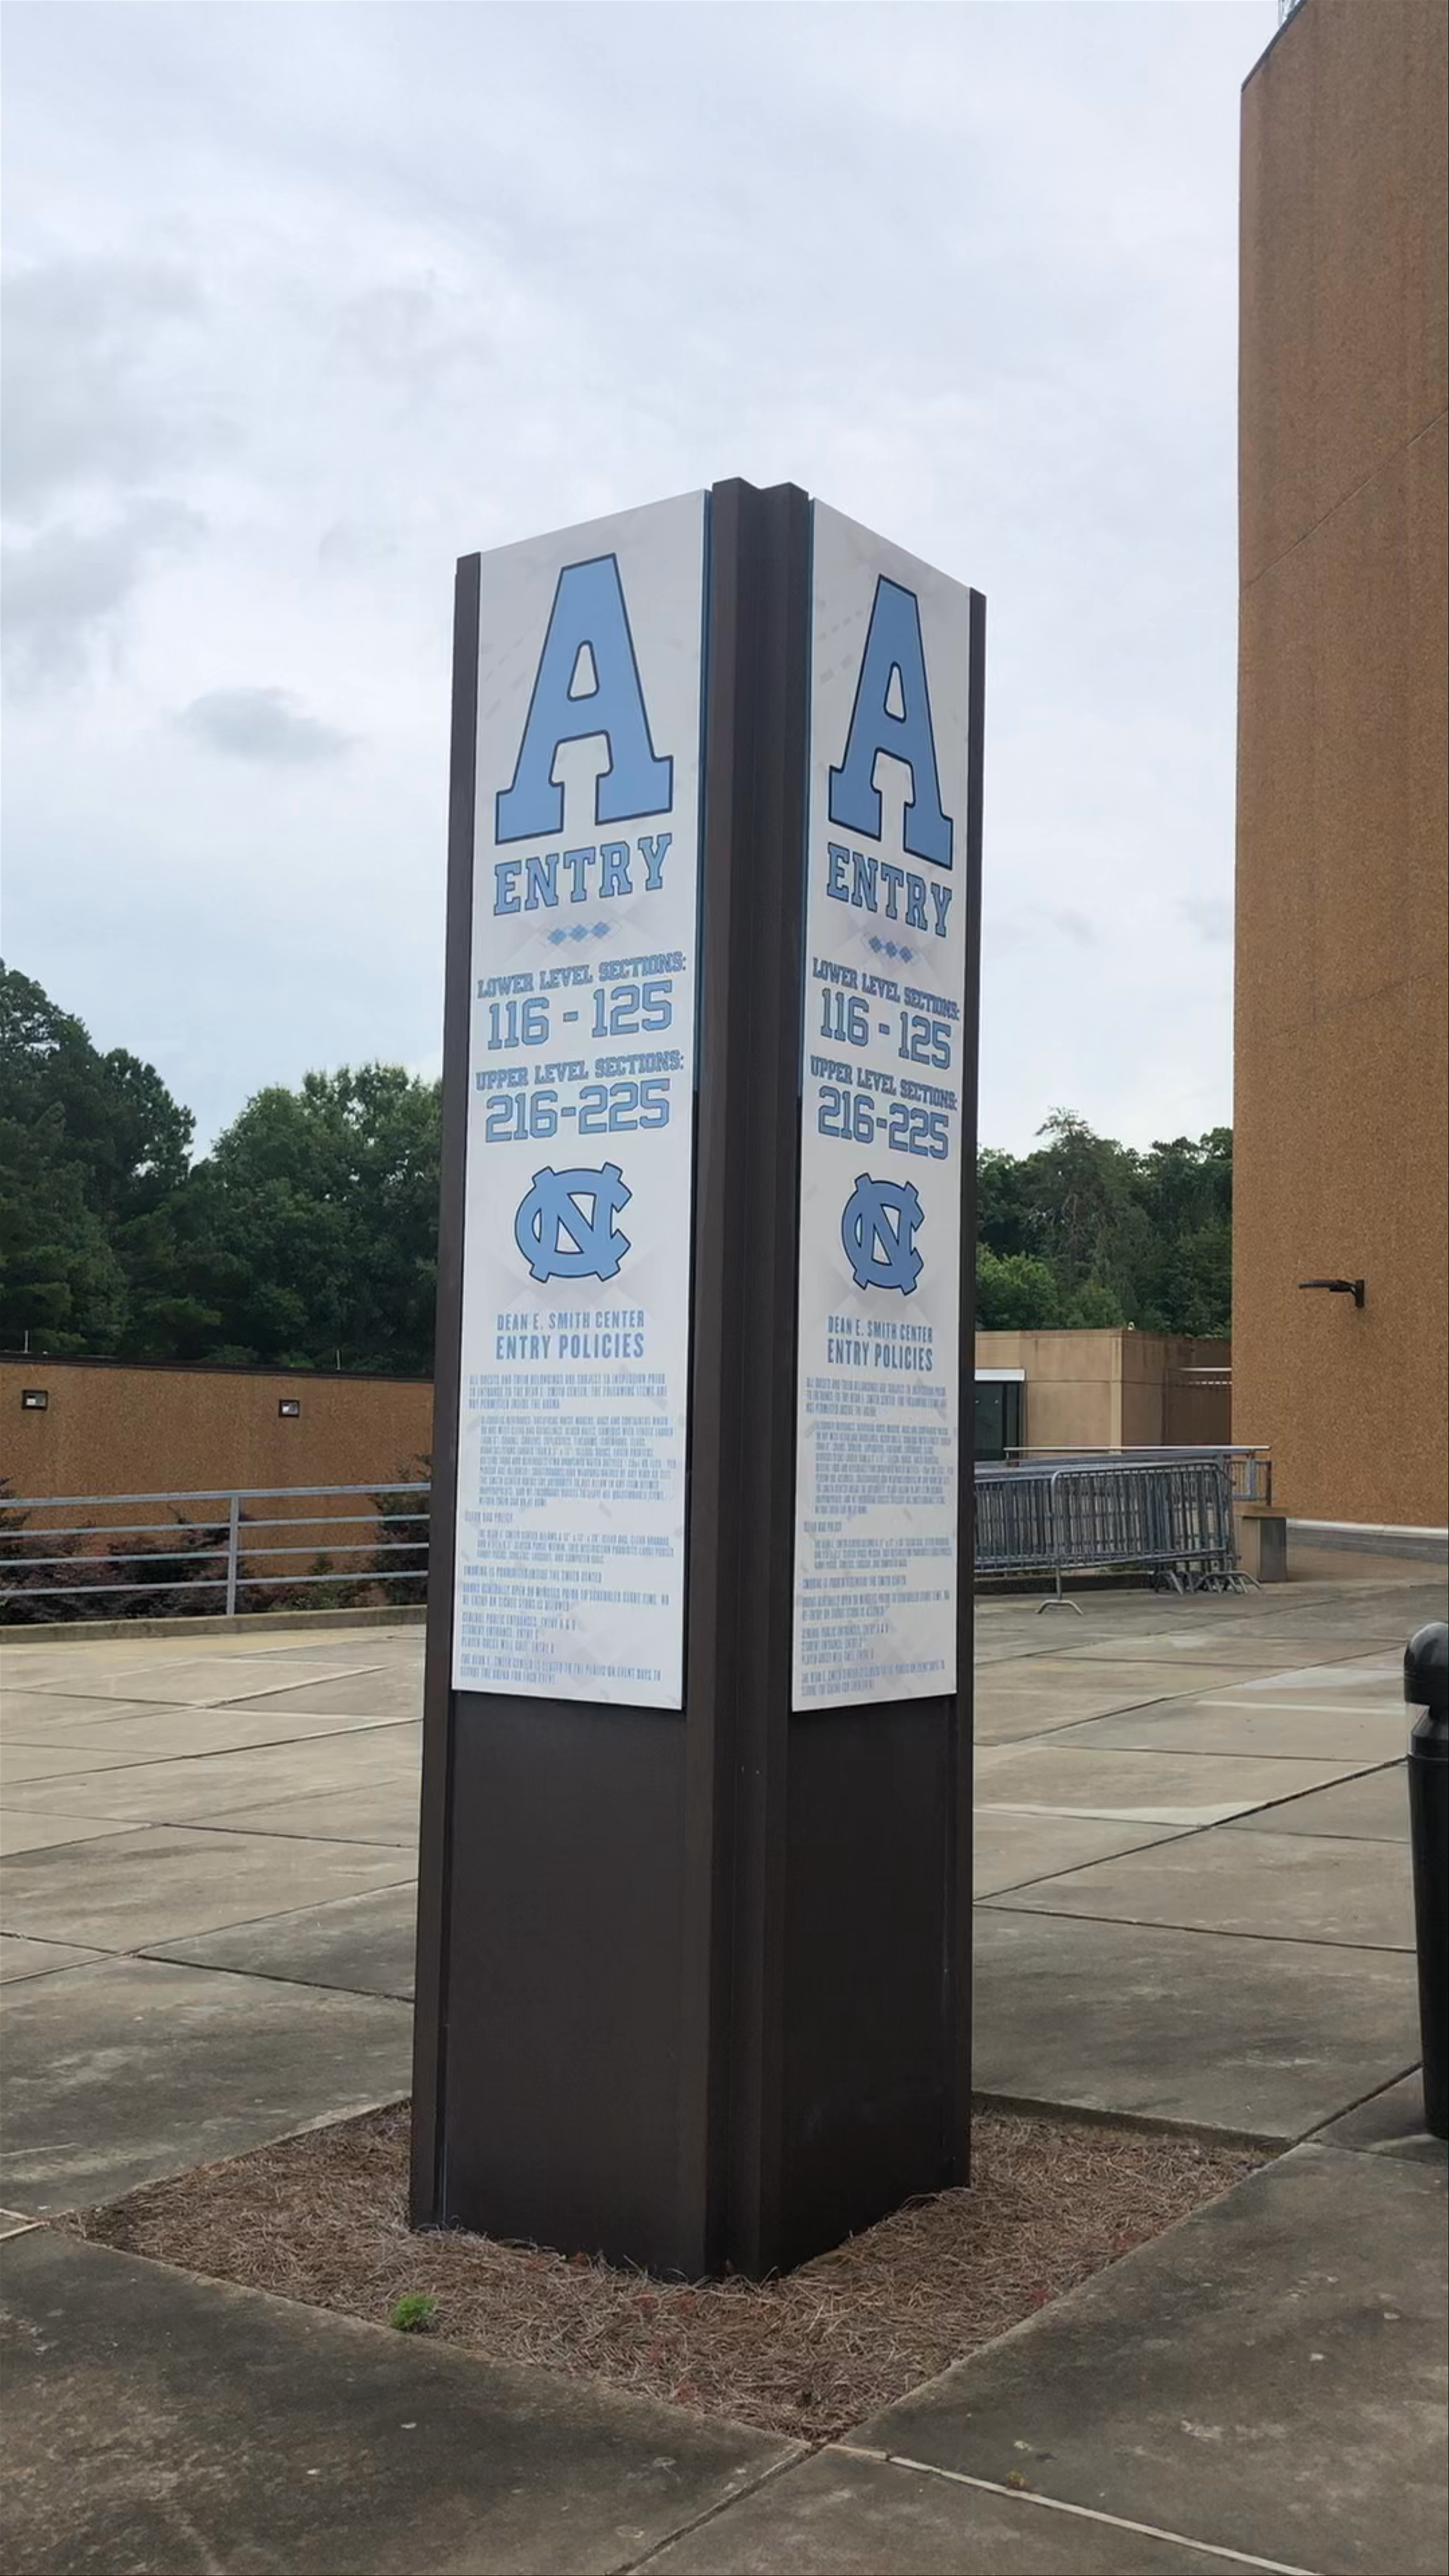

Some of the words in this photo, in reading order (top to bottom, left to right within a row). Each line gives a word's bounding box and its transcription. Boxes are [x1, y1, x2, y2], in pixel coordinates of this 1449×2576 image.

[495, 552, 673, 845] A
[828, 574, 953, 870] A
[493, 833, 672, 916] ENTRY
[827, 841, 952, 937] ENTRY
[478, 974, 534, 998] LOWER
[540, 964, 593, 990] LEVEL
[598, 952, 686, 982] SECTIONS:
[813, 957, 857, 989] LOWER
[862, 973, 900, 1003] LEVEL
[904, 987, 960, 1021] SECTIONS:
[487, 997, 549, 1050] 116
[592, 981, 673, 1038] 125
[820, 988, 869, 1048] 116
[899, 1012, 952, 1069] 125
[475, 1066, 529, 1090] UPPER
[535, 1060, 588, 1084] LEVEL
[594, 1049, 684, 1078] SECTIONS:
[811, 1055, 853, 1086] UPPER
[857, 1067, 896, 1097] LEVEL
[900, 1080, 957, 1110] SECTIONS:
[485, 1078, 671, 1143] 216-225
[818, 1085, 949, 1161] 216-225
[496, 1335, 551, 1360] ENTRY
[559, 1333, 645, 1359] POLICIES
[497, 1313, 530, 1332] DEAN
[549, 1311, 590, 1330] SMITH
[595, 1310, 645, 1329] CENTER
[828, 1315, 852, 1335] DEAN
[867, 1321, 897, 1340] SMITH
[900, 1324, 933, 1343] CENTER
[828, 1338, 869, 1366] ENTRY
[875, 1343, 933, 1372] POLICIES
